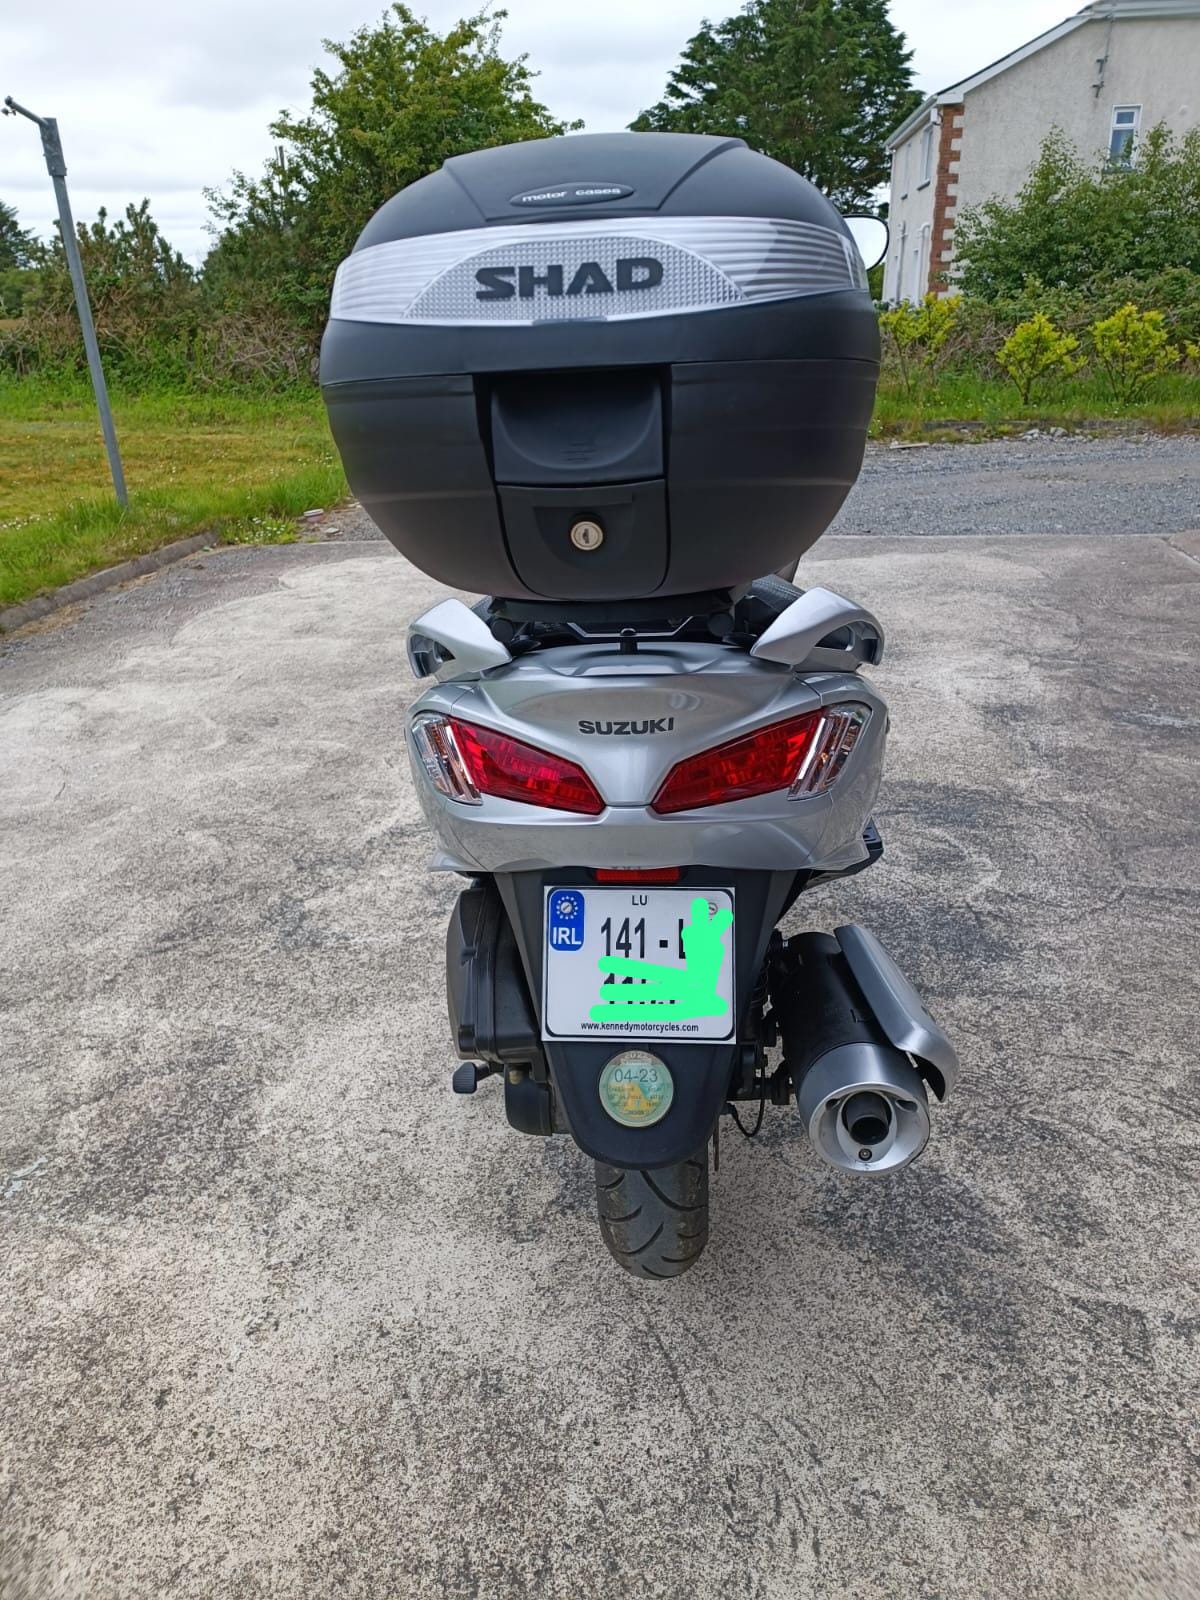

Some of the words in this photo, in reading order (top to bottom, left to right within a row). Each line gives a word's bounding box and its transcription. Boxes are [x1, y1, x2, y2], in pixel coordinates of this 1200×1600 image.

[523, 192, 568, 202] motor
[575, 187, 621, 195] cases
[474, 257, 664, 302] SHAD
[578, 717, 675, 735] SUZUKI
[631, 895, 648, 906] LU
[552, 926, 582, 945] IRL
[600, 917, 645, 958] 141
[580, 1021, 699, 1034] www.kennedymotorcycles.com
[614, 1068, 658, 1083] 04-23
